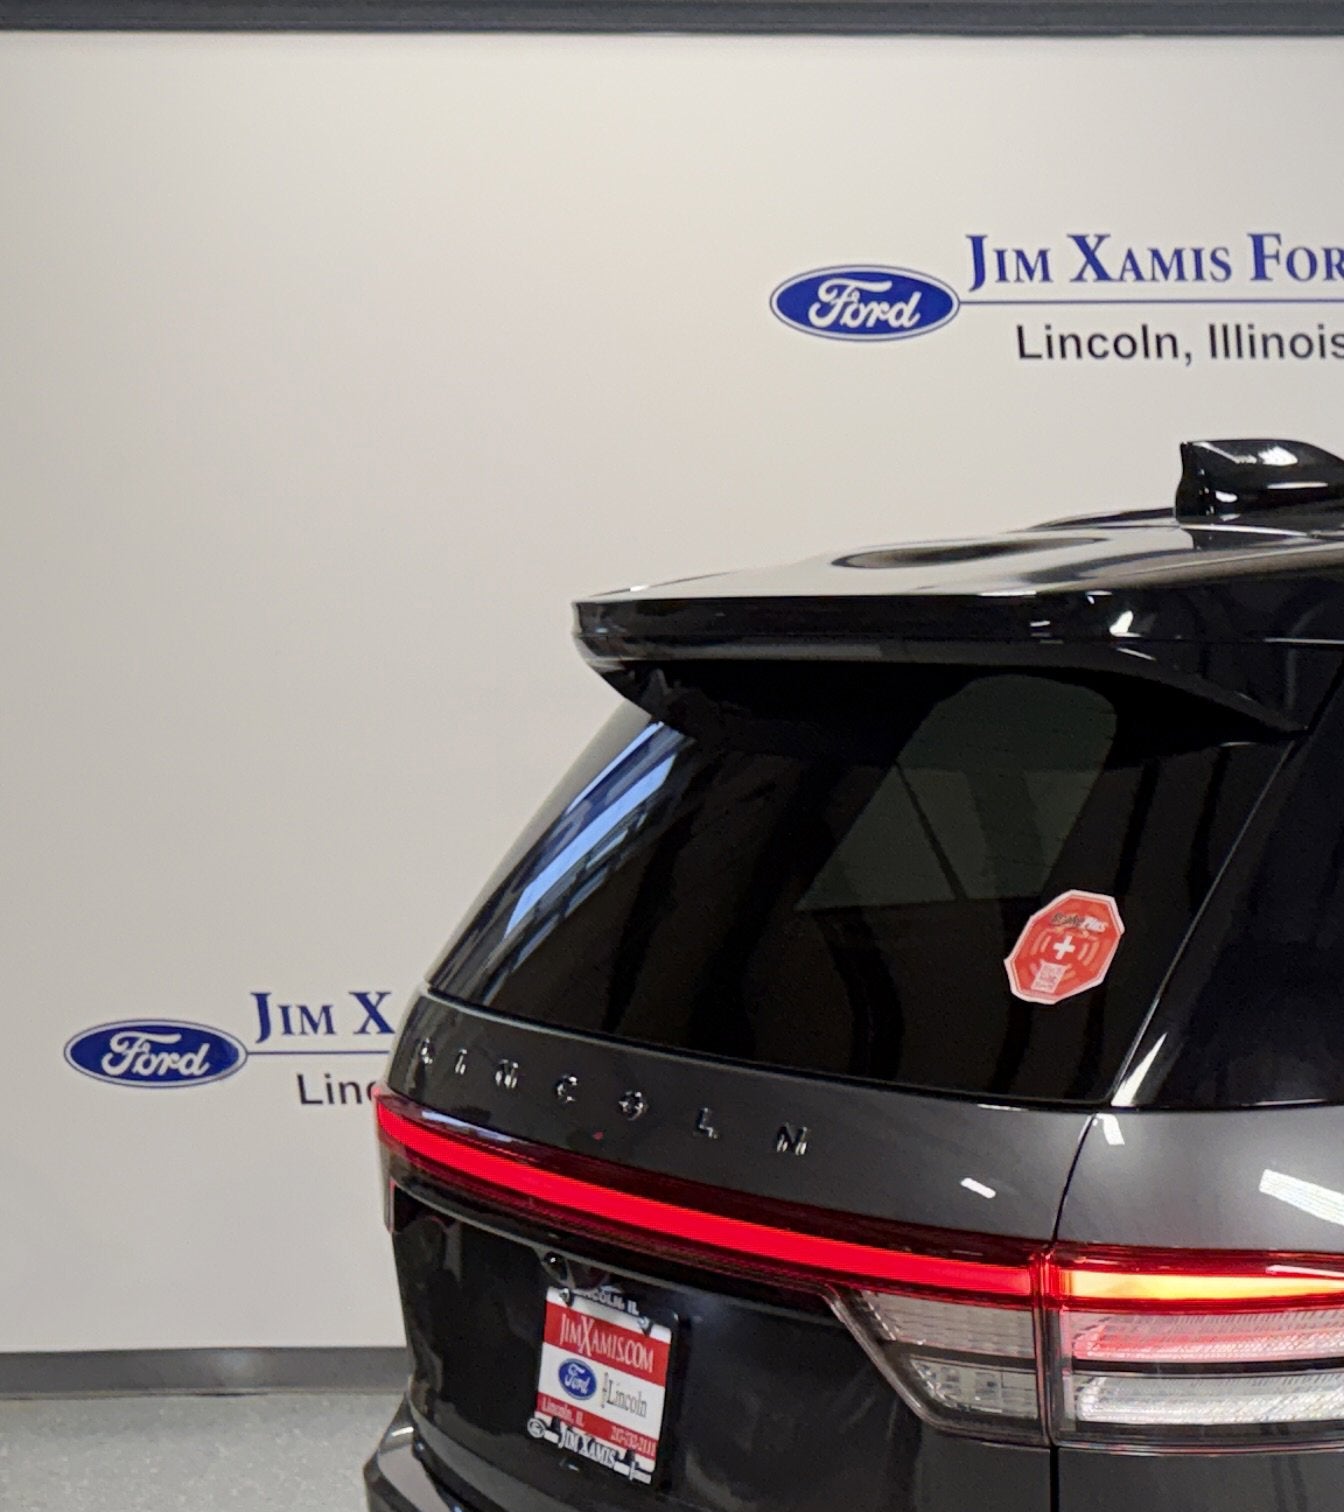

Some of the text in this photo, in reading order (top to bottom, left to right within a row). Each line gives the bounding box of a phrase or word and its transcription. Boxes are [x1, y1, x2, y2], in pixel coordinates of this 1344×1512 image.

[966, 234, 1052, 293] JIM
[1067, 234, 1233, 283] XAMIS
[808, 278, 921, 328] Ford
[1017, 324, 1193, 367] Lincoln,
[250, 992, 337, 1044] JIM
[101, 1031, 211, 1077] Ford
[565, 1363, 591, 1395] Ford
[607, 1379, 648, 1418] Lincoln
